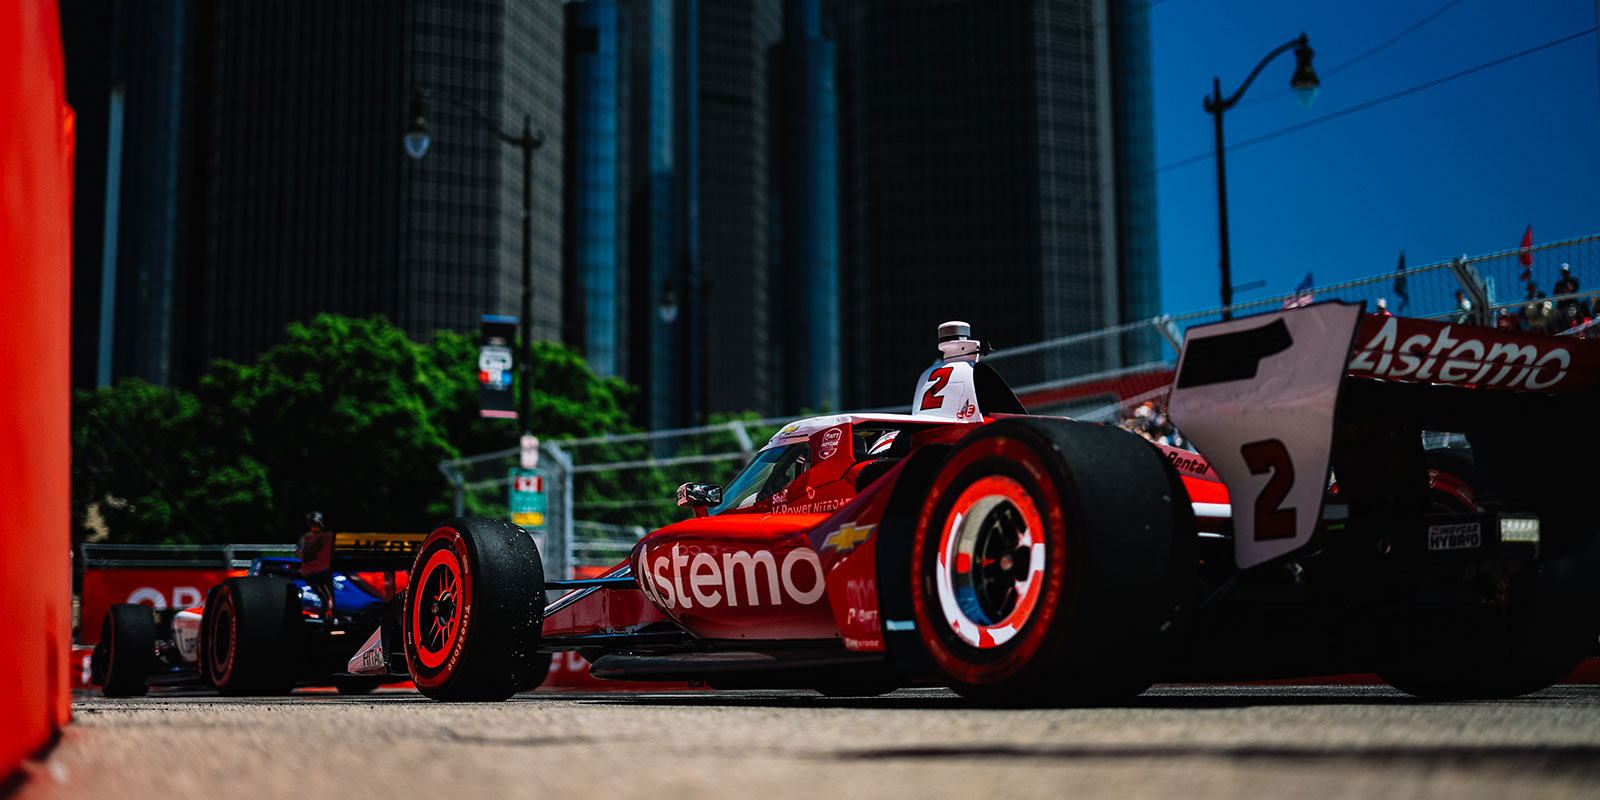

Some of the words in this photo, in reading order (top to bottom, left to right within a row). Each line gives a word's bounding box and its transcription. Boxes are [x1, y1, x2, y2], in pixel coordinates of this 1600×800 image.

[1349, 317, 1571, 389] Astemo
[920, 366, 954, 411] 2
[1240, 438, 1297, 542] 2
[355, 540, 422, 551] HERT
[638, 542, 827, 610] Astemo
